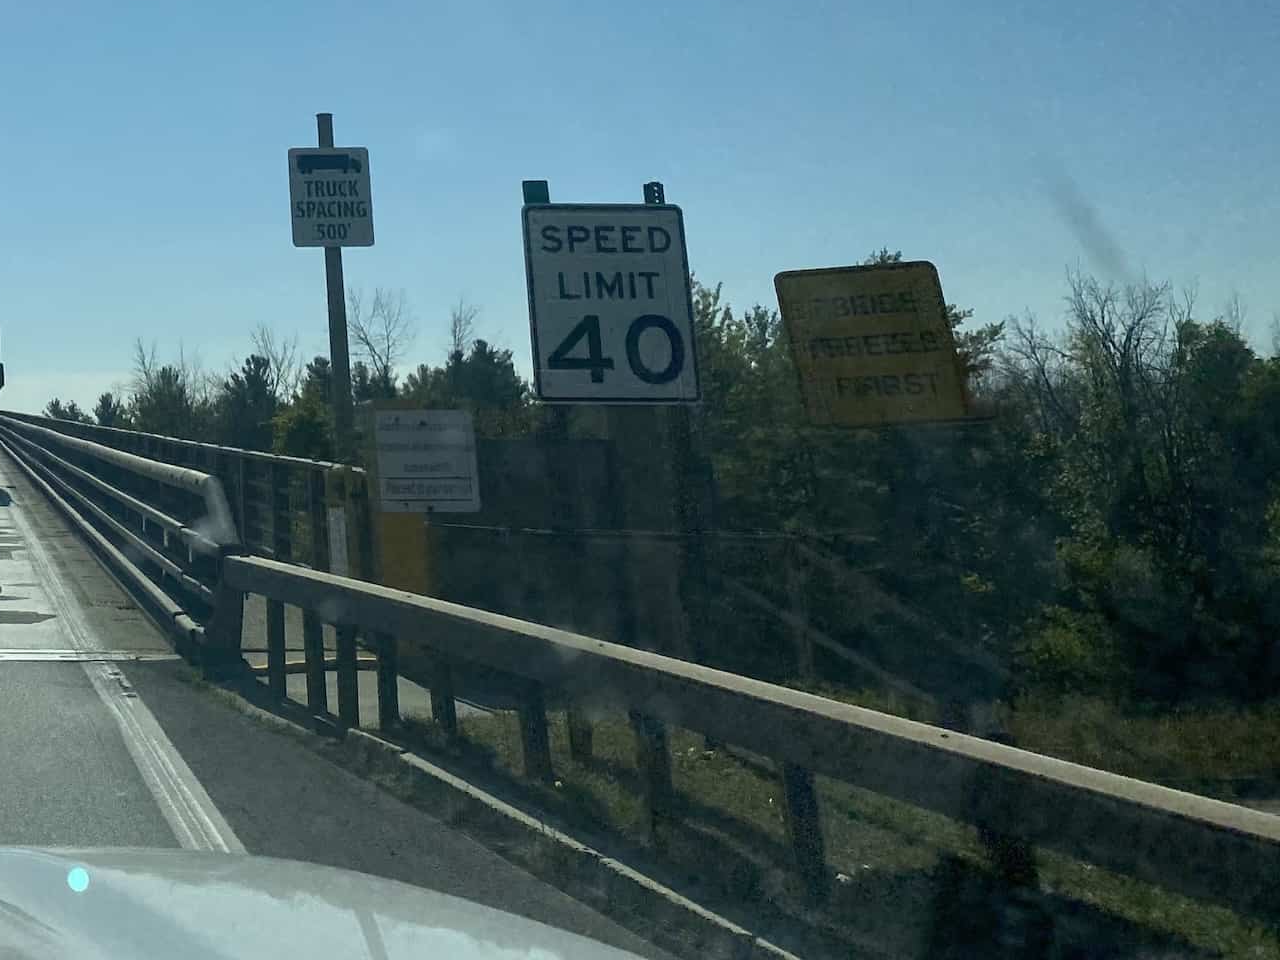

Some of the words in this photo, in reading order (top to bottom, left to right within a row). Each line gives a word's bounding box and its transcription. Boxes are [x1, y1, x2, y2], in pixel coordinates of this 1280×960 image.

[304, 180, 359, 197] TRUCK
[295, 200, 368, 218] SPACING
[541, 225, 671, 253] SPEED
[558, 271, 660, 300] LIMIT
[547, 314, 685, 385] 40
